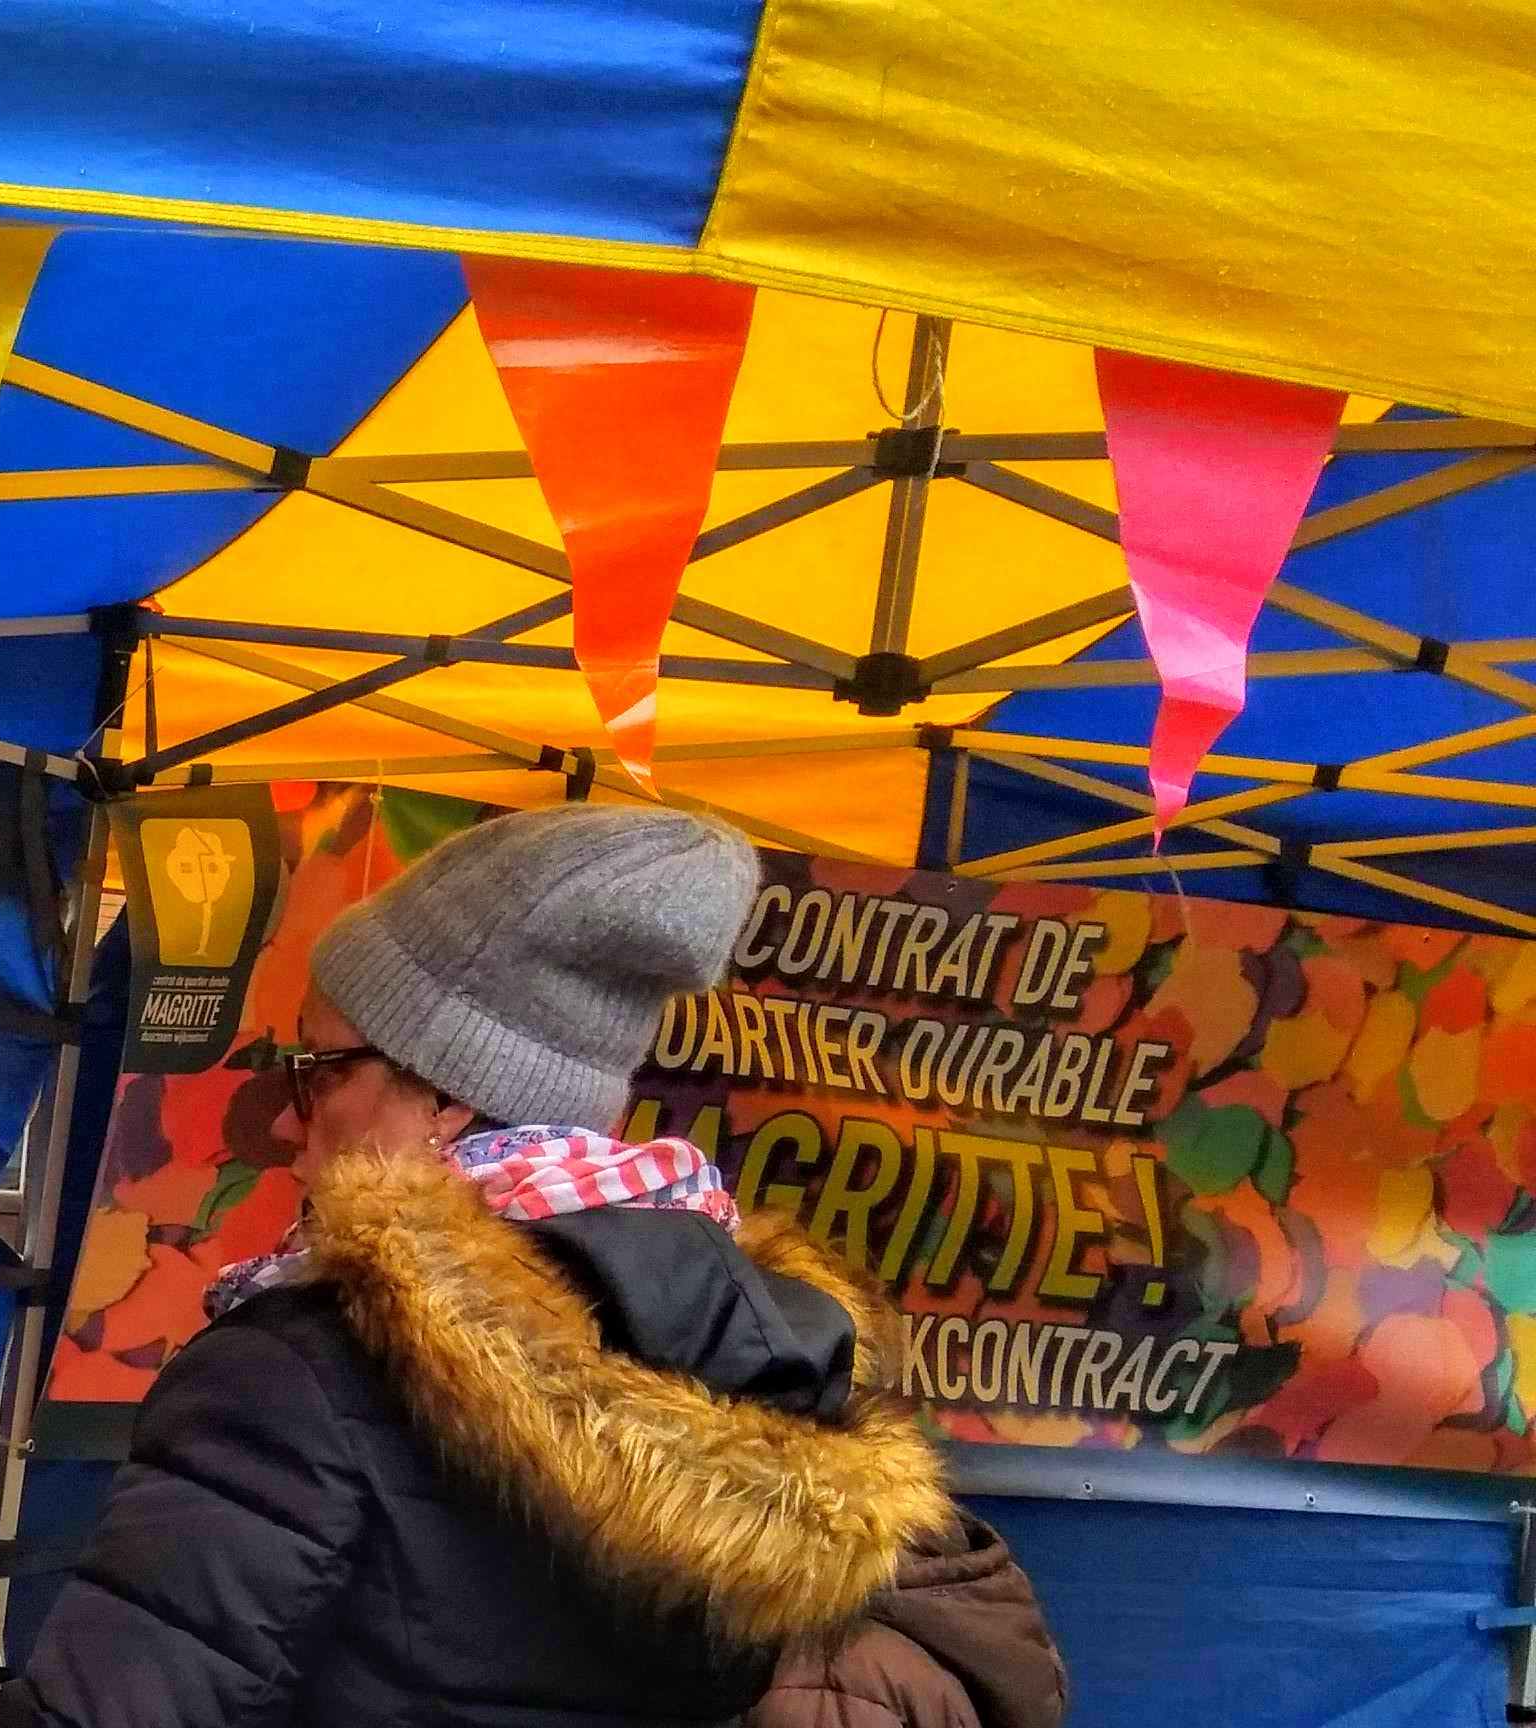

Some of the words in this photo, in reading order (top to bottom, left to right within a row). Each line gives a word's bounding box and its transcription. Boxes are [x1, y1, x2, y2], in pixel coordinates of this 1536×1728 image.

[734, 884, 1019, 1000] CONTRAT
[1012, 919, 1106, 1009] DE
[140, 992, 225, 1026] MAGRITTE
[653, 994, 888, 1095] UARTIER
[900, 1019, 1168, 1127] DURABLE
[894, 1311, 1239, 1414] KCONTRACT
